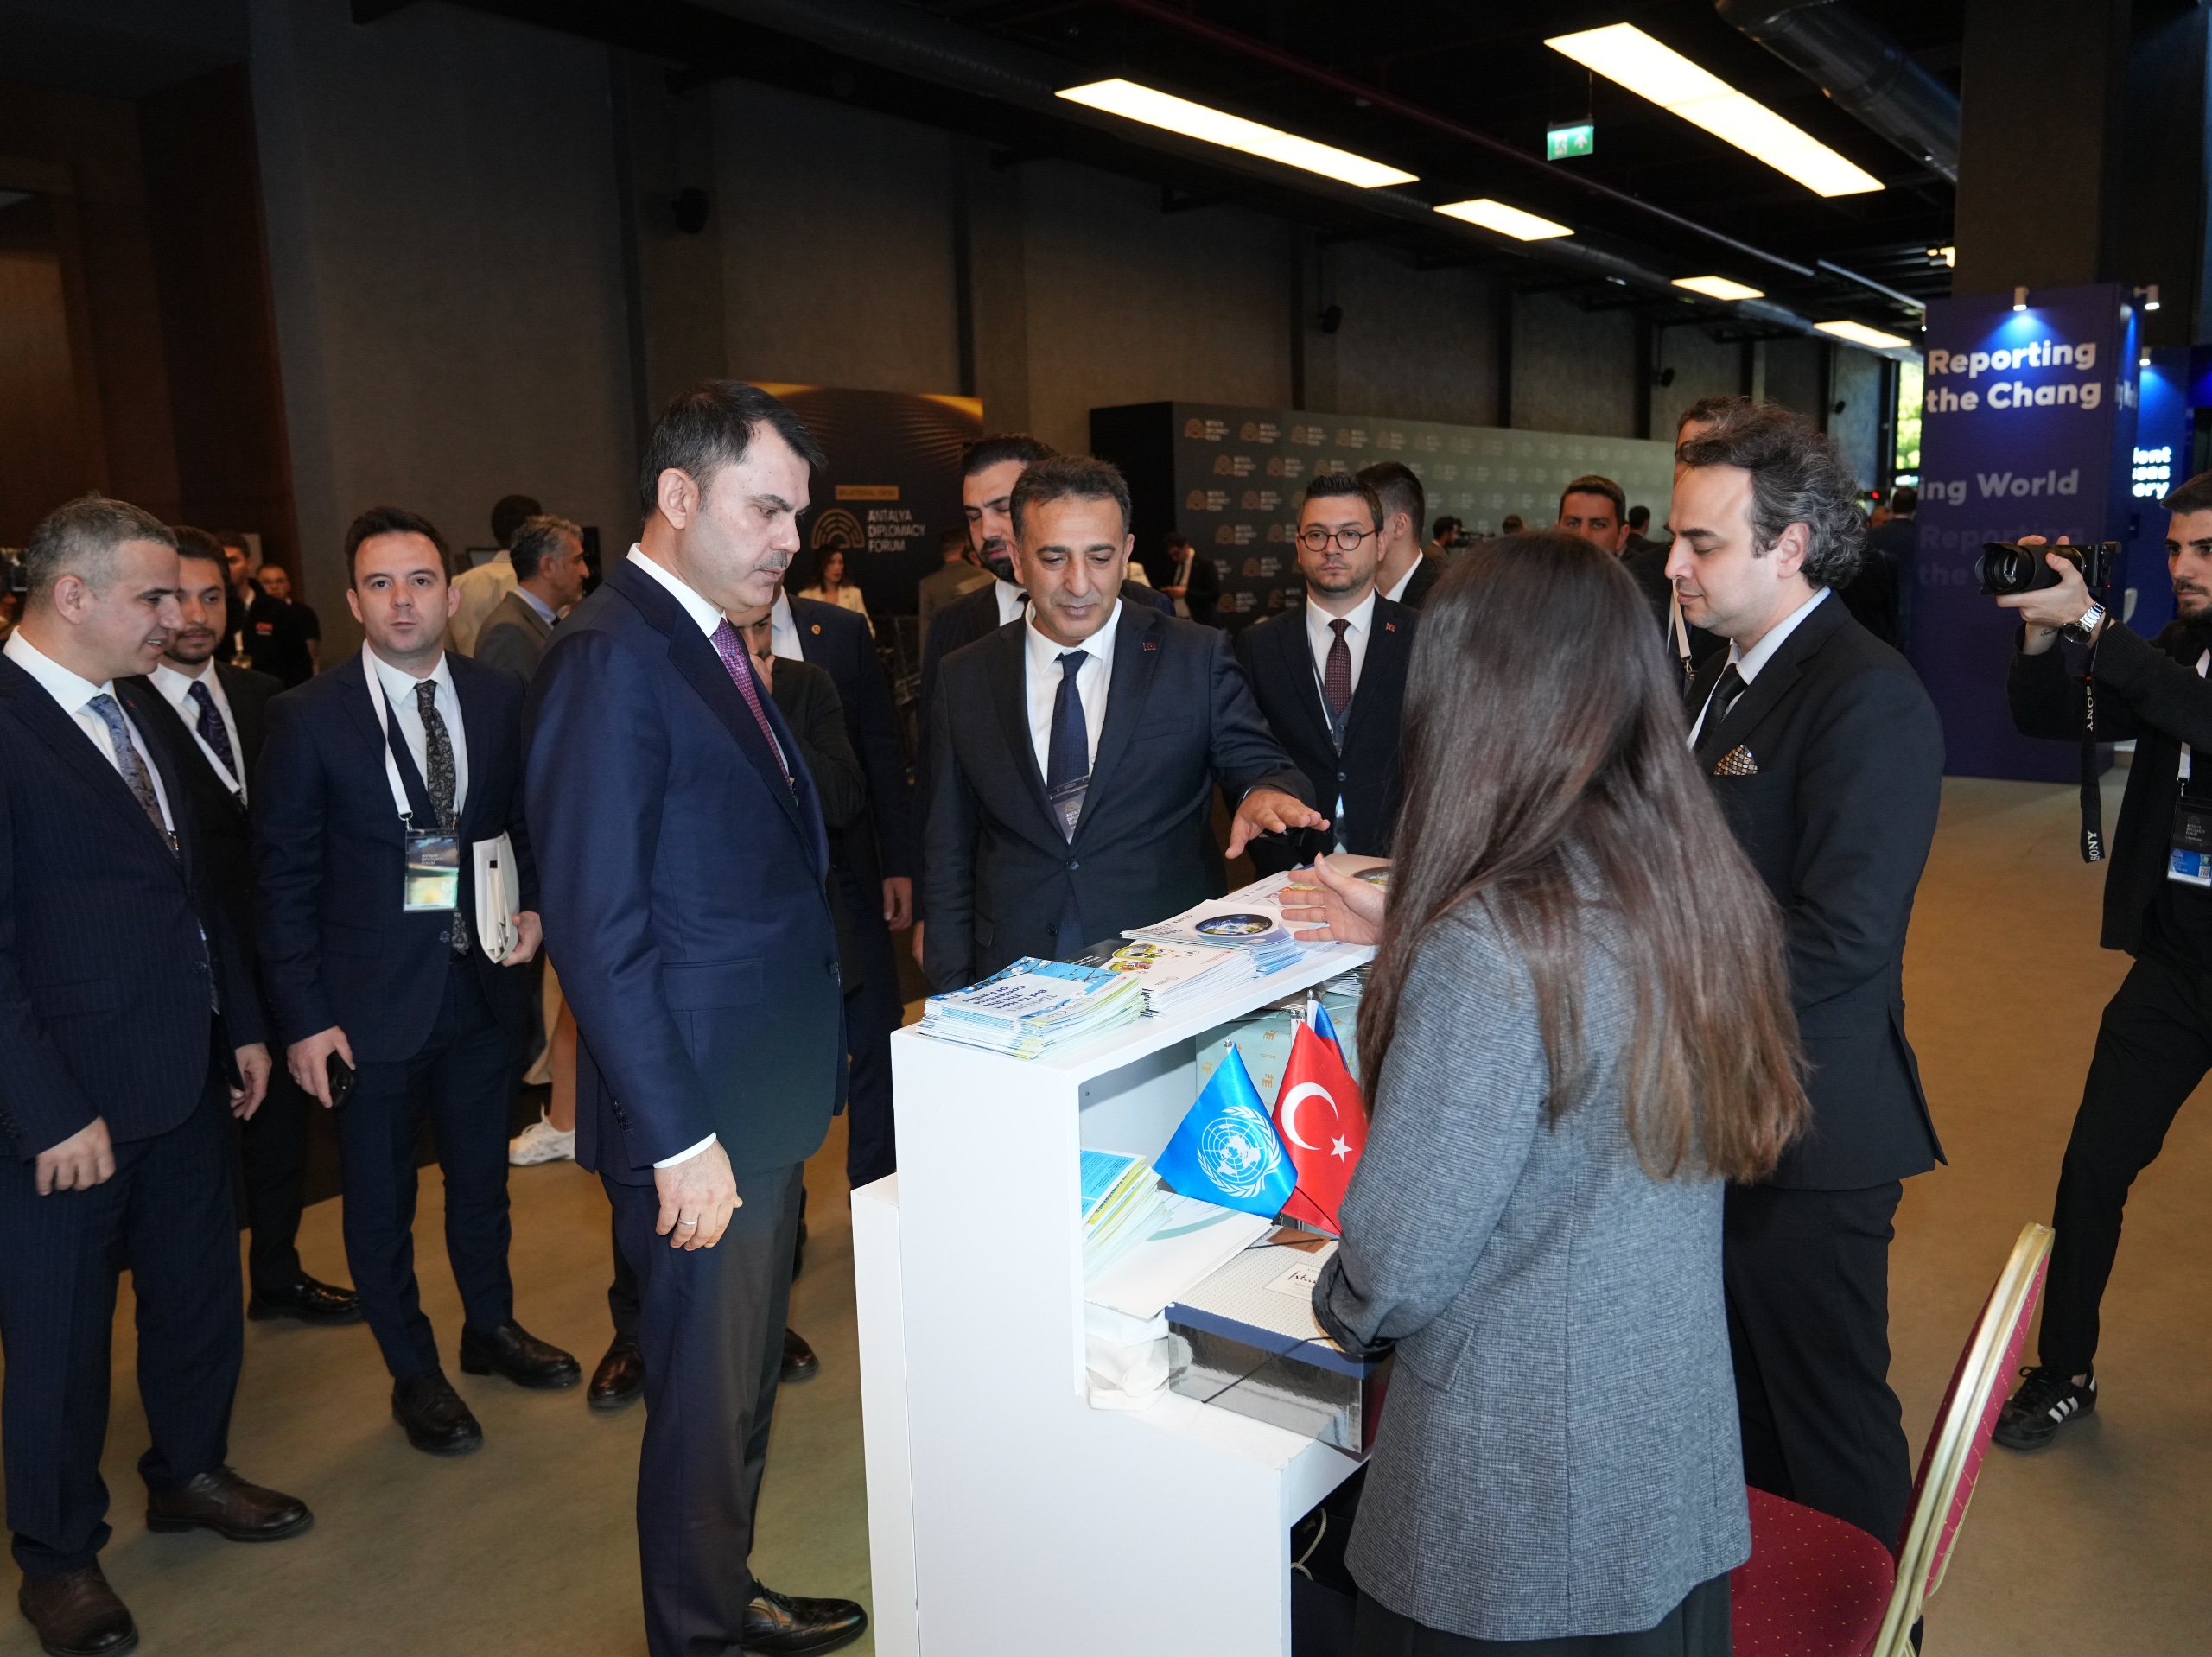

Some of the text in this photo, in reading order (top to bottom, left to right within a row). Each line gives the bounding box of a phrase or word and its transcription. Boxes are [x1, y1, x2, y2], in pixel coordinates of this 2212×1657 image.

[1928, 340, 2096, 378] Reporting
[1926, 387, 1979, 413] the
[1987, 381, 2101, 409] Chang
[1917, 469, 2078, 505] ing World
[868, 509, 912, 522] ANTALYA
[867, 523, 925, 537] DIPLOMACY
[868, 538, 905, 552] FORUM
[2087, 829, 2100, 861] SONY
[974, 985, 1026, 1005] Conference
